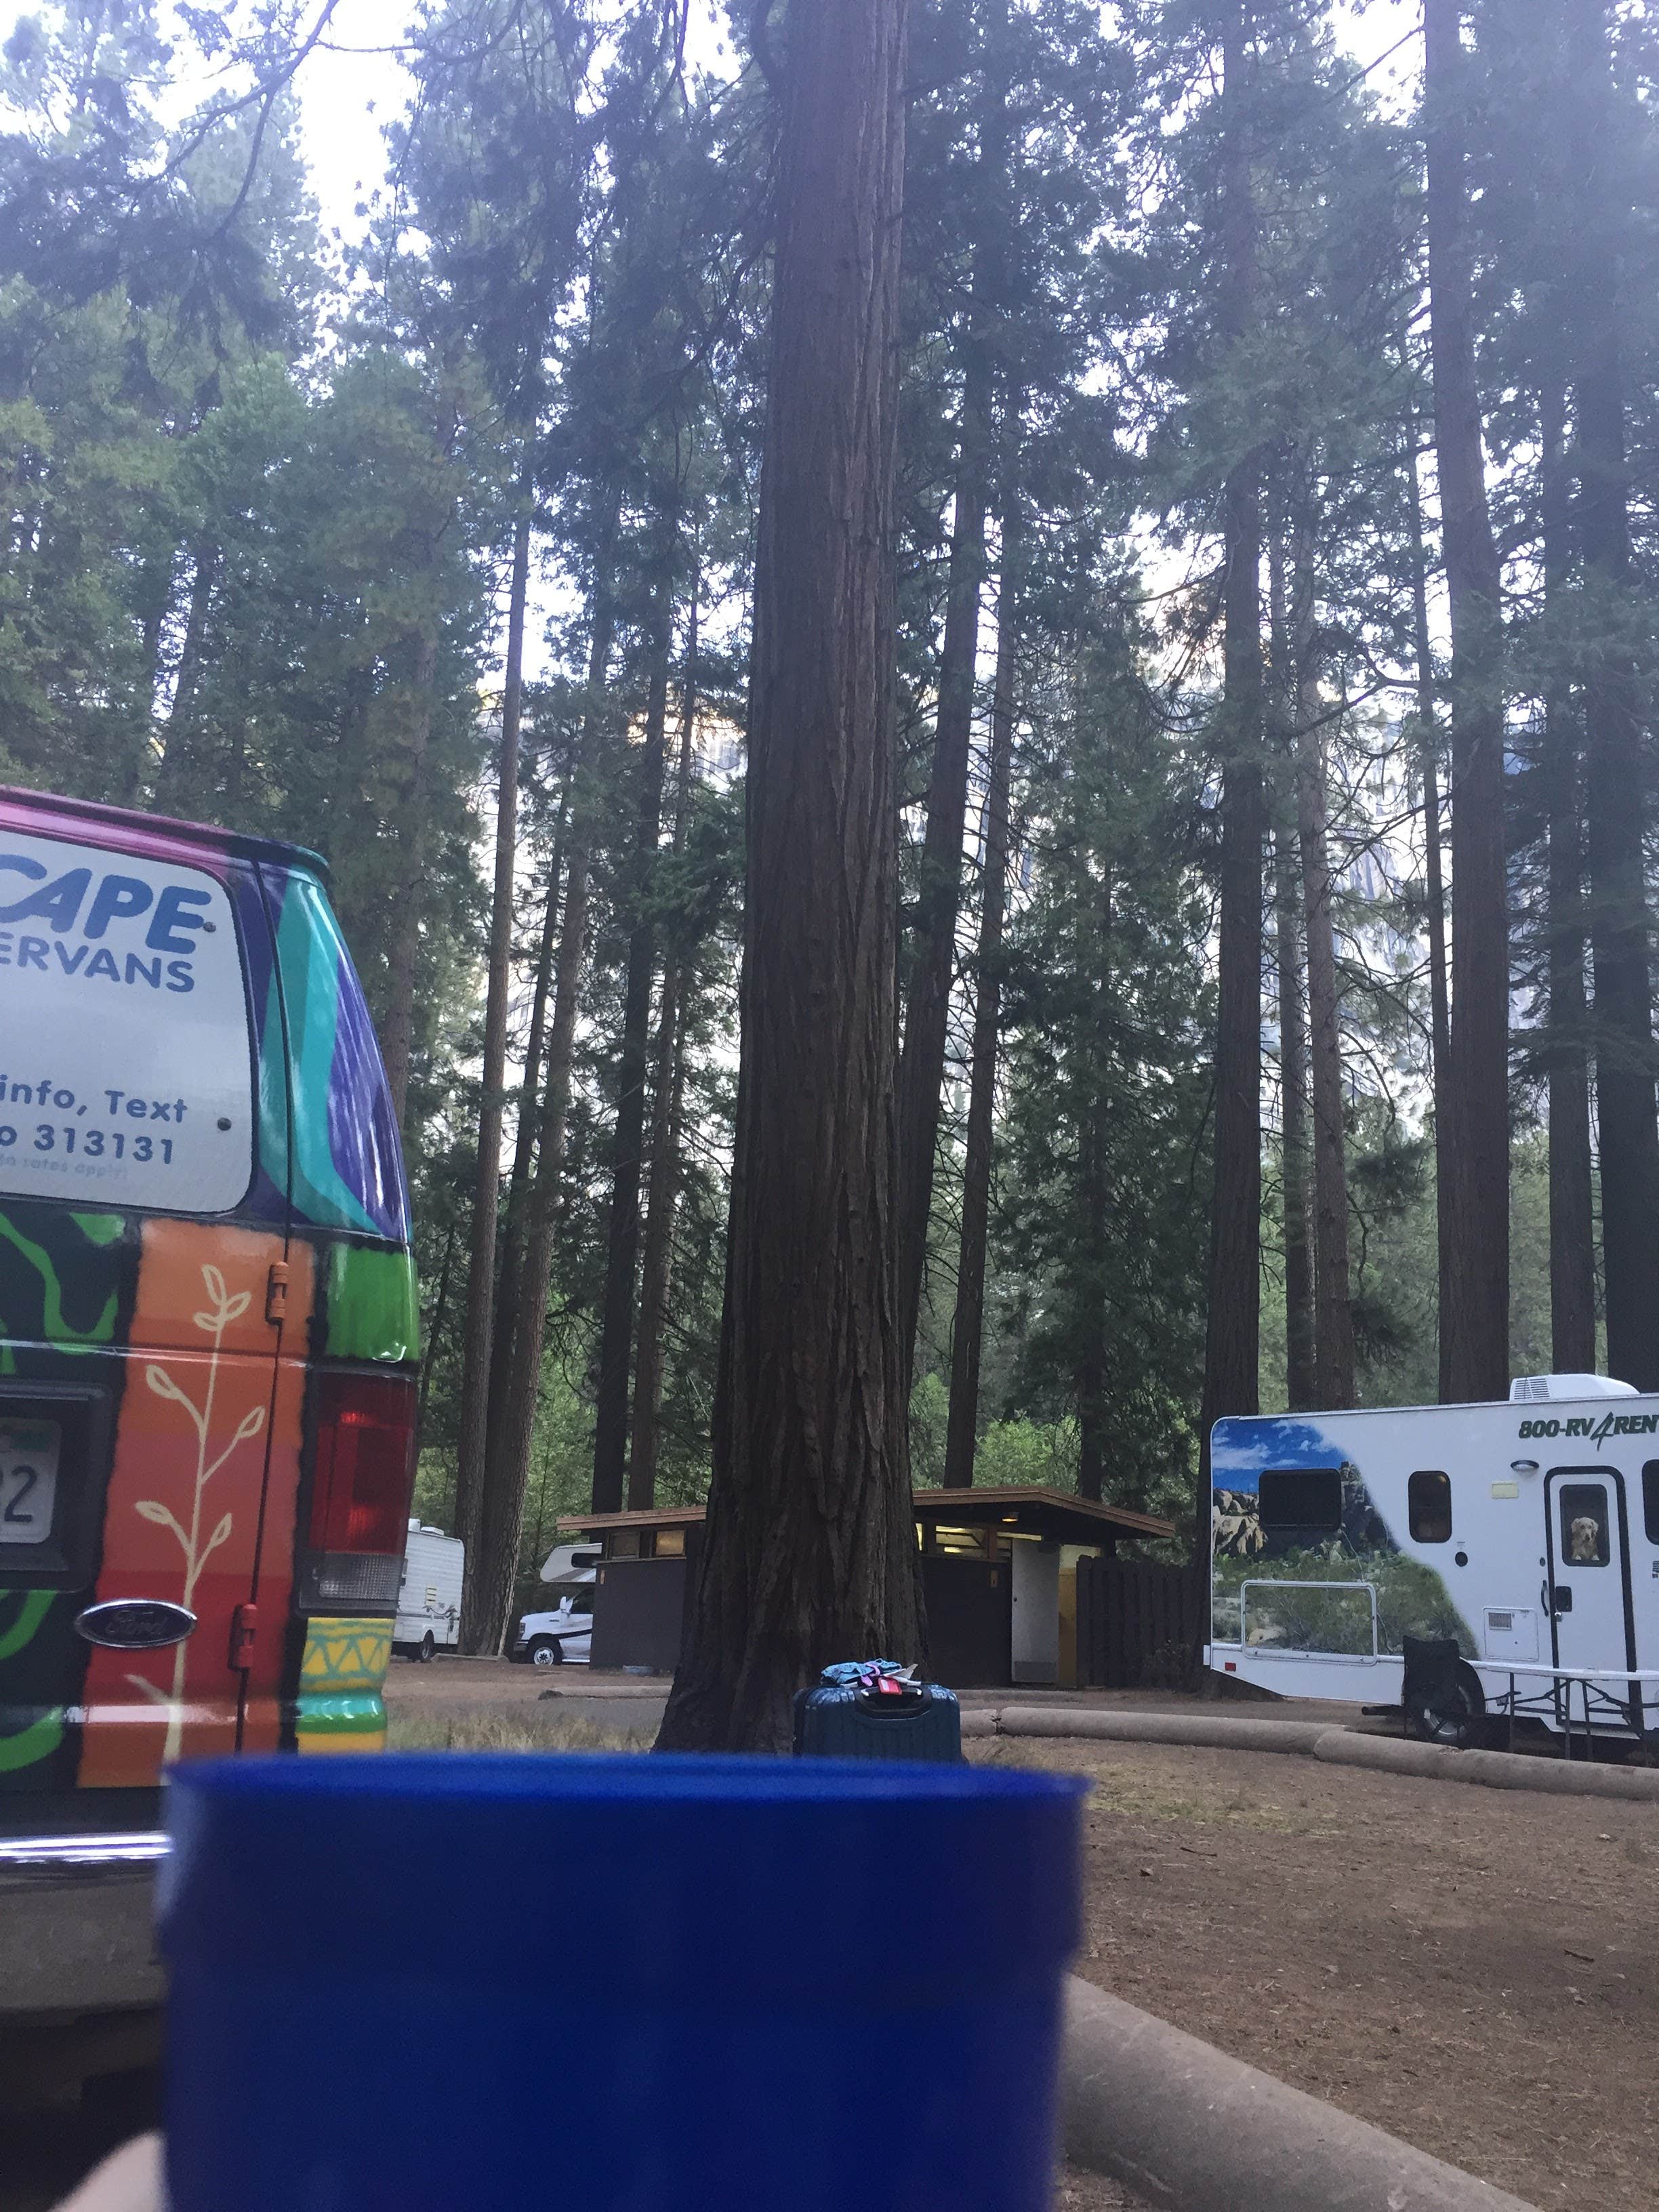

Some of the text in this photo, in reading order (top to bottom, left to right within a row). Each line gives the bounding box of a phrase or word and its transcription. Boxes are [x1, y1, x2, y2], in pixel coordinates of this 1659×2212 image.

[0, 1074, 188, 1123] info, Text
[33, 1124, 173, 1164] 313131
[1518, 1411, 1659, 1452] 800-RV4REN
